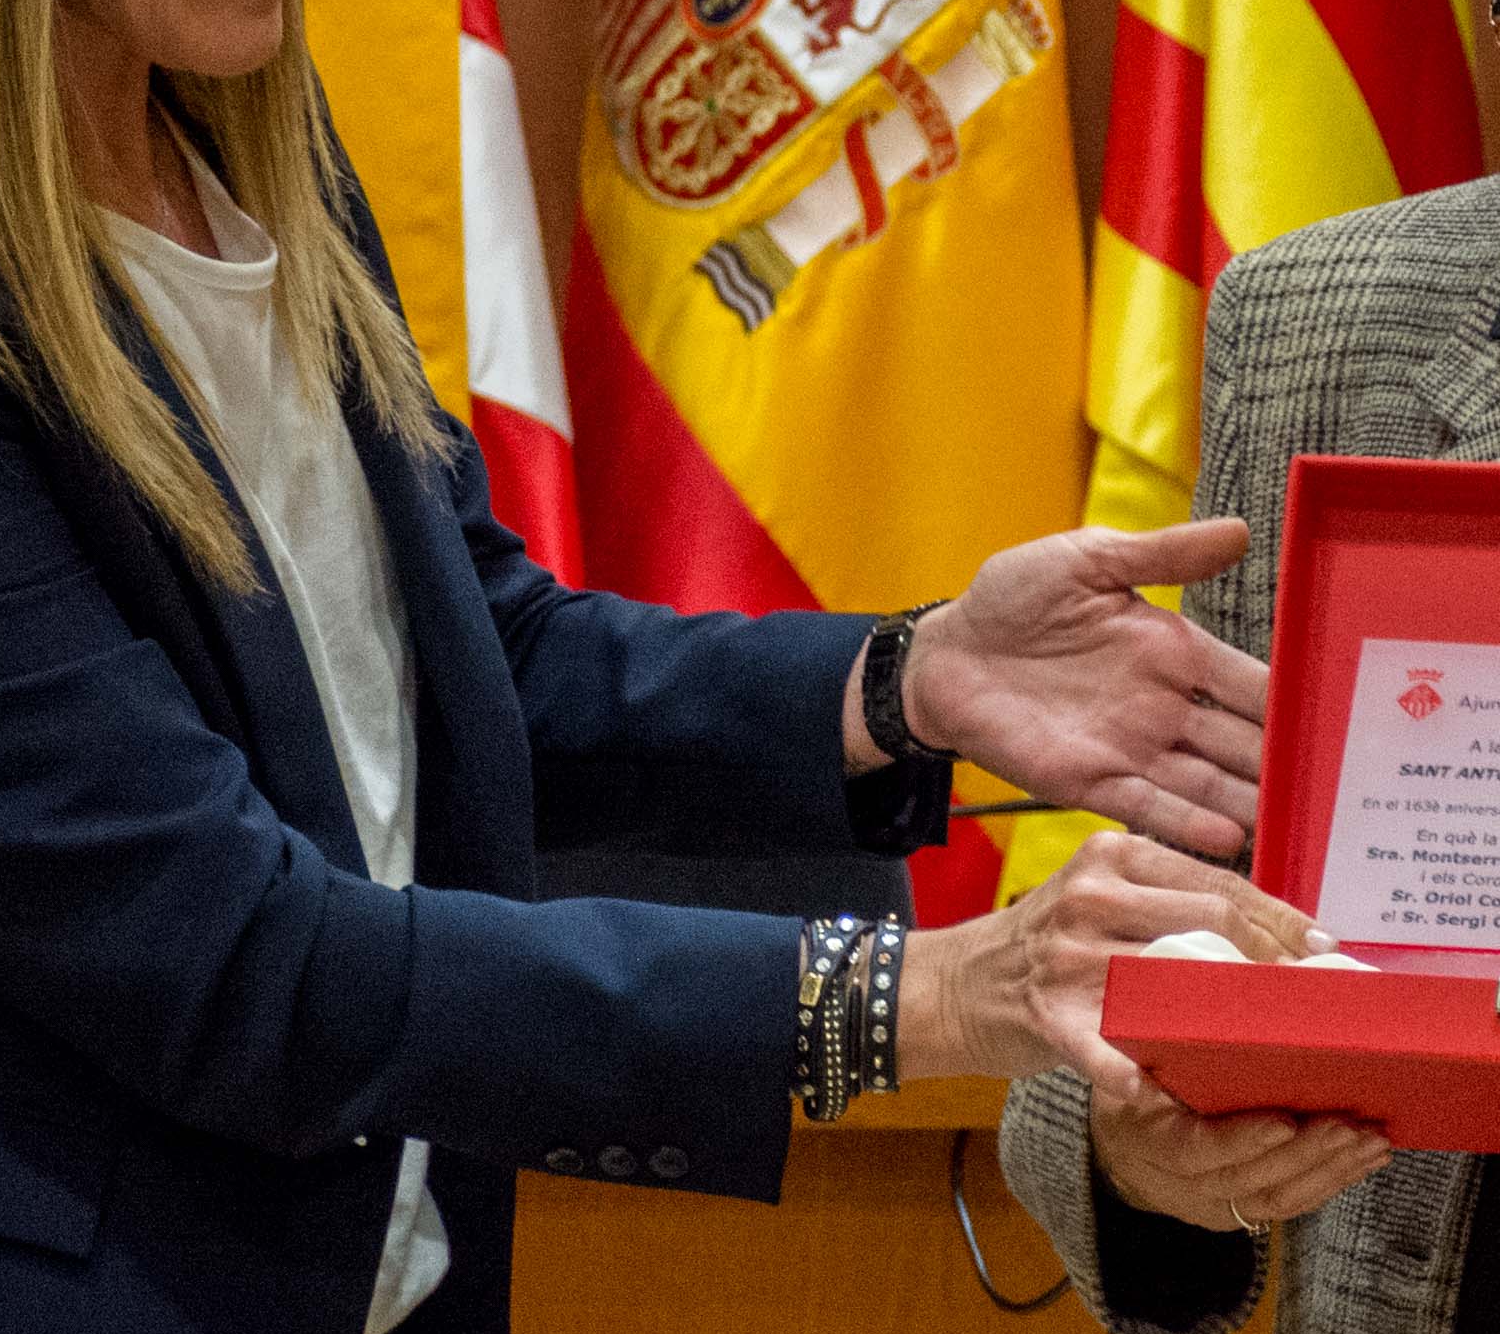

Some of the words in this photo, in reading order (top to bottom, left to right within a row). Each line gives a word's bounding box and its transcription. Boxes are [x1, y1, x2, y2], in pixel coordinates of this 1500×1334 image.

[1470, 739, 1482, 753] A
[1399, 764, 1452, 778] SANT
[1362, 798, 1380, 810] En
[1386, 799, 1399, 811] el
[1416, 829, 1438, 842] En
[1444, 831, 1477, 846] què
[1483, 832, 1497, 846] la
[1366, 847, 1404, 861] Sra.
[1431, 871, 1457, 885] els
[1390, 889, 1418, 903] Sr.
[1425, 891, 1472, 906] Oriol
[1380, 910, 1396, 923] el
[1401, 911, 1428, 924] Sr.
[1436, 912, 1486, 929] Sergi
